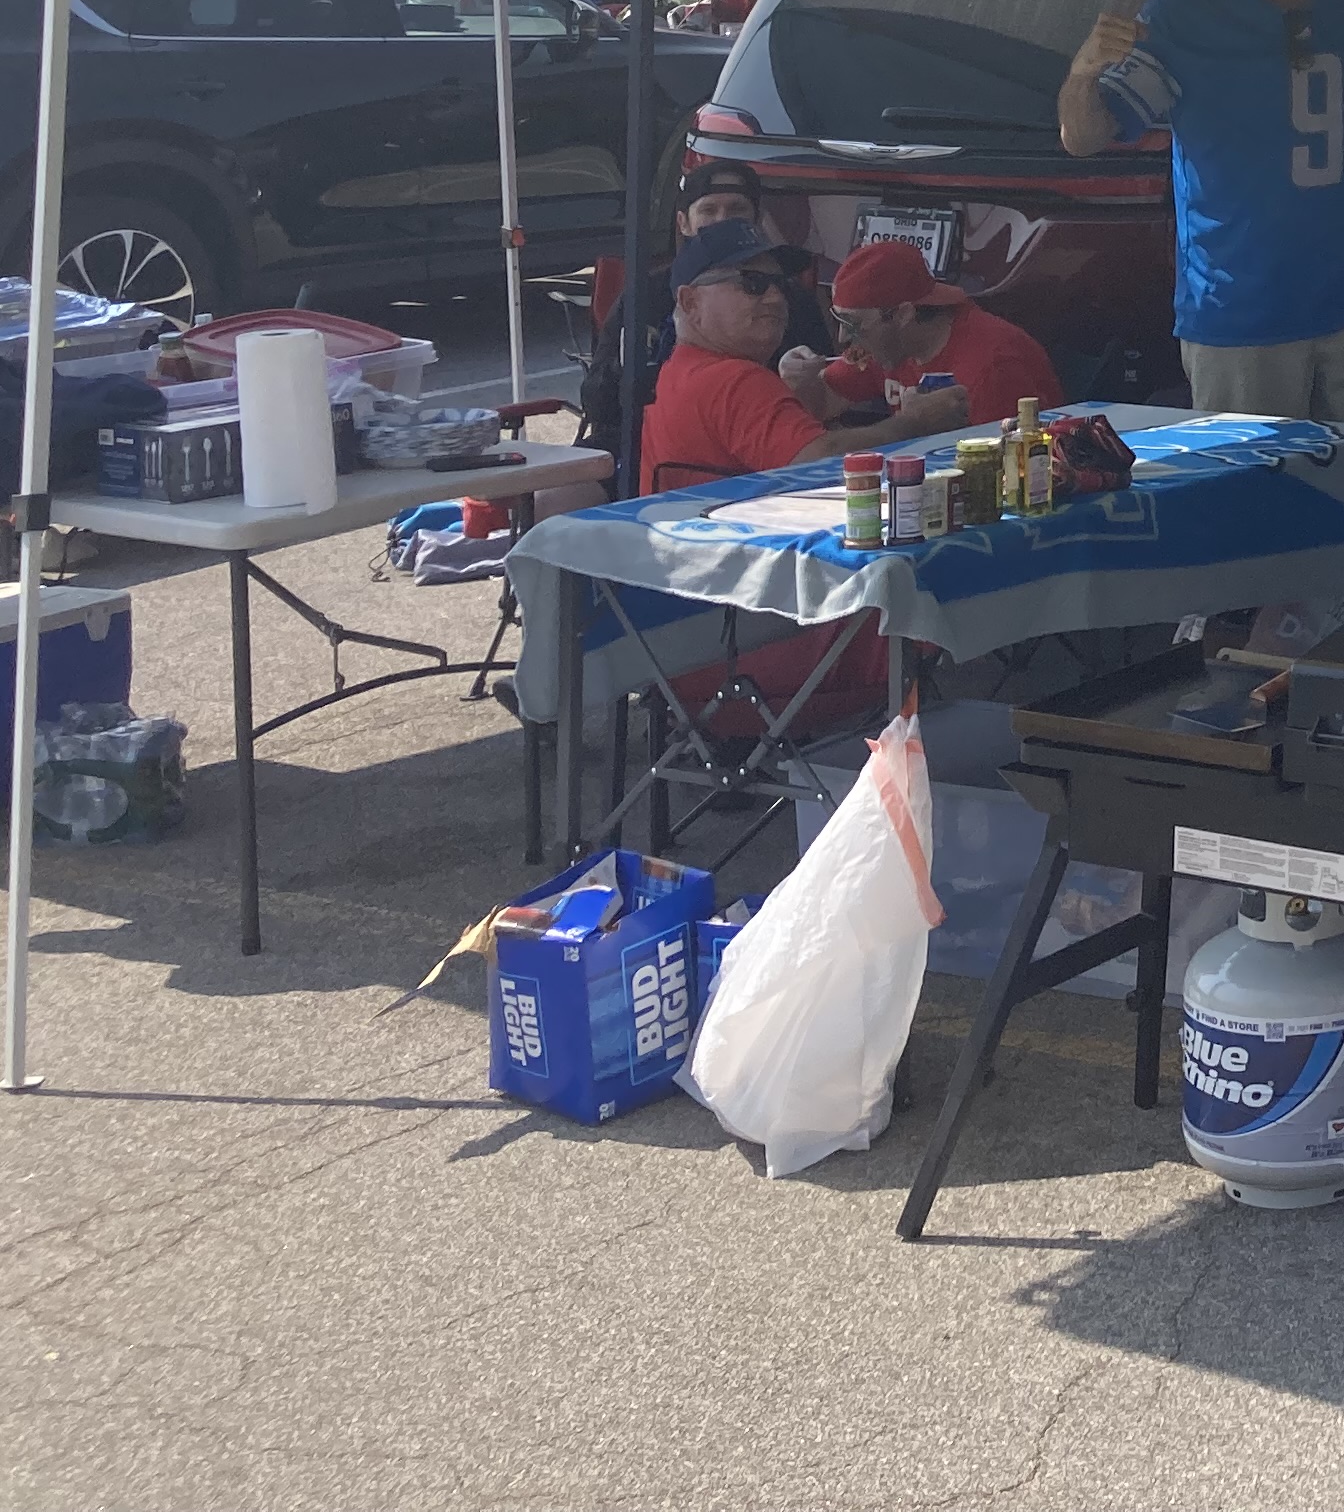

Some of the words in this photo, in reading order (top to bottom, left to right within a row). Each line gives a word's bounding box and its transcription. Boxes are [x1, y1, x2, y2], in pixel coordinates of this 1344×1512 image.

[1289, 51, 1344, 188] 9
[500, 977, 527, 1066] LIGHT
[516, 993, 542, 1057] BUD
[631, 963, 664, 1056] BUD
[658, 936, 690, 1061] LIGHT
[1201, 1011, 1218, 1025] FIND
[1219, 1018, 1227, 1029] A
[1227, 1021, 1260, 1033] STORE
[1183, 1021, 1249, 1073] Blue
